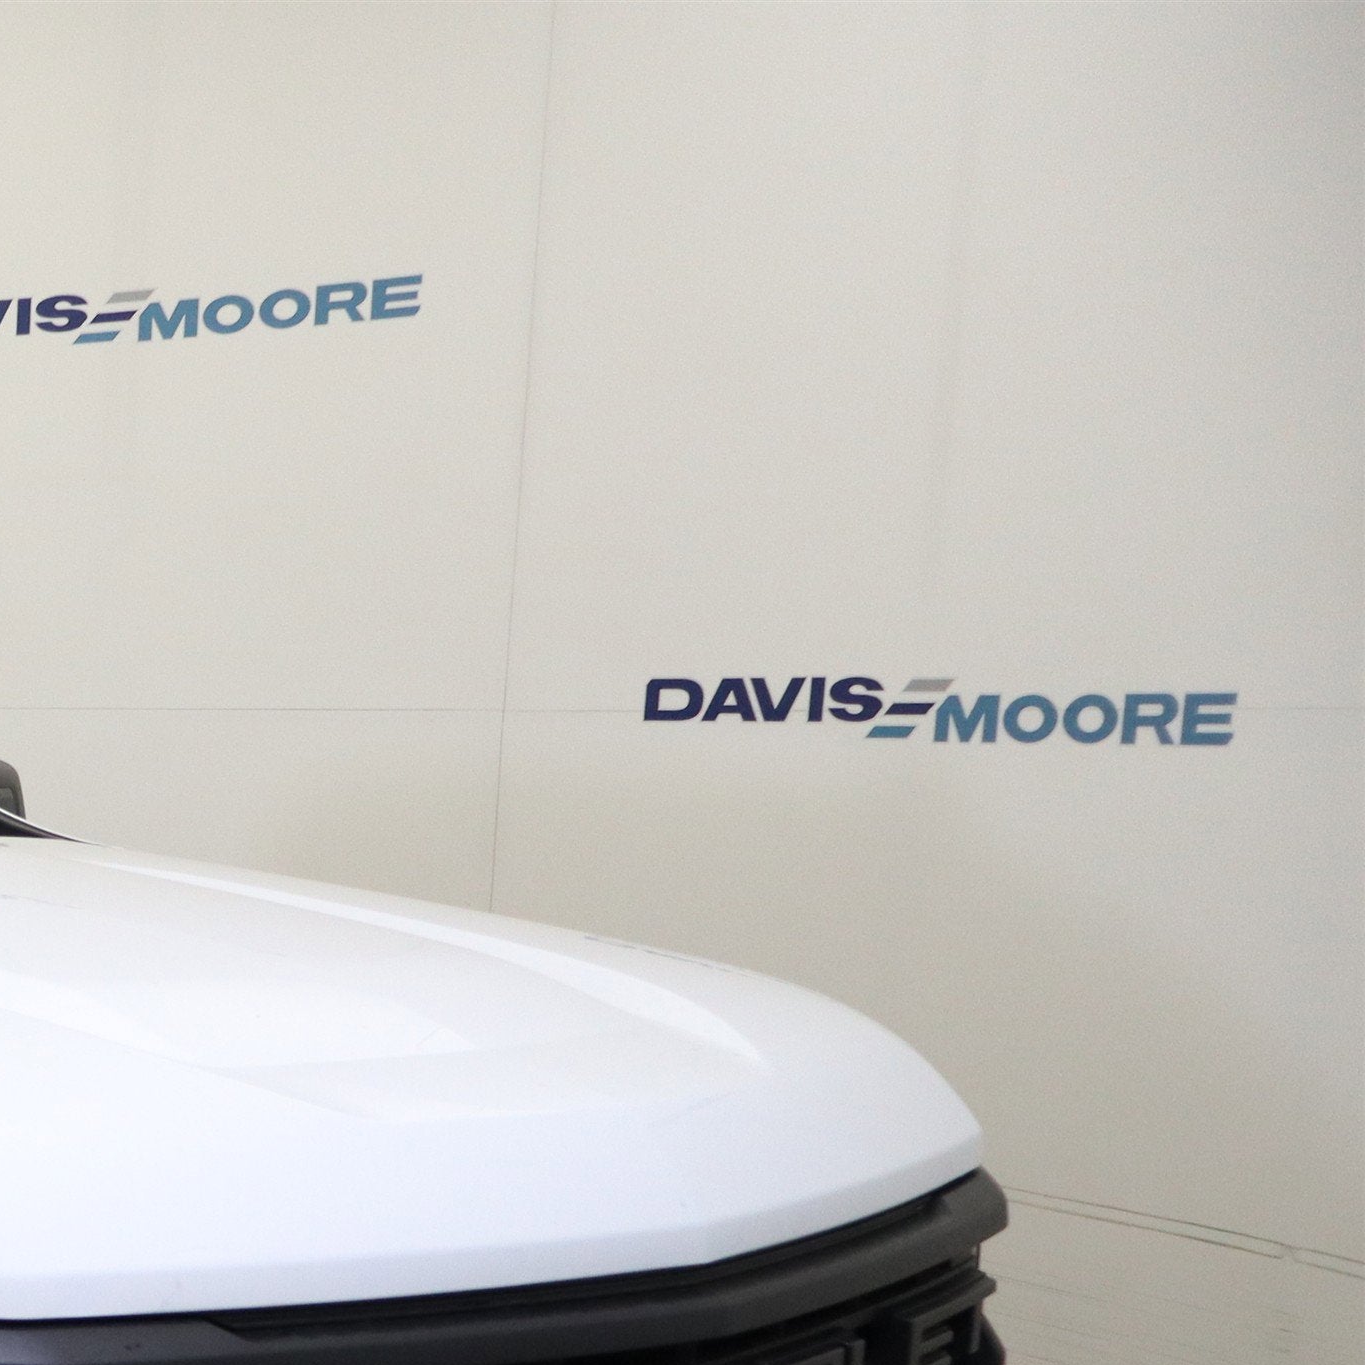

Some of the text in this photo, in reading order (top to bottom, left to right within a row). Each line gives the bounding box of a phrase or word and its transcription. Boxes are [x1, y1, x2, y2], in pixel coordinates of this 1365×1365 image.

[136, 273, 424, 342] MOORE
[642, 676, 1239, 746] DAVIS MOORE
